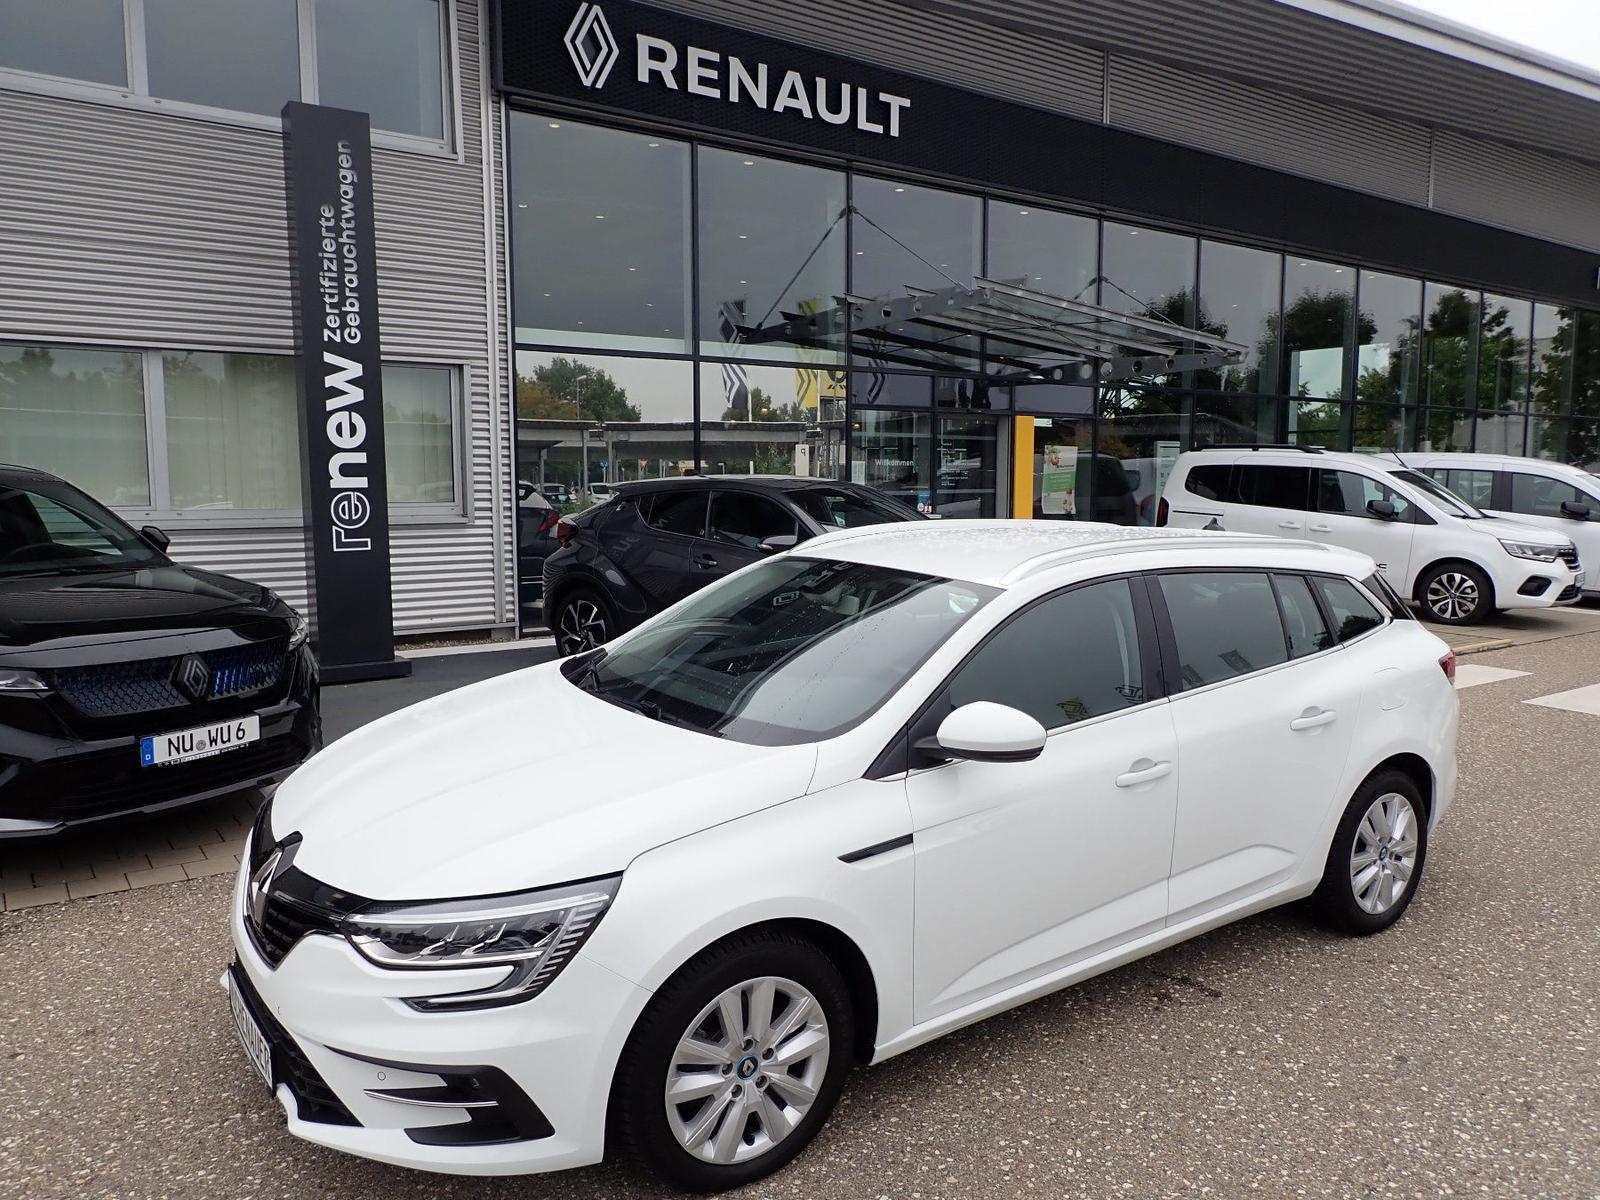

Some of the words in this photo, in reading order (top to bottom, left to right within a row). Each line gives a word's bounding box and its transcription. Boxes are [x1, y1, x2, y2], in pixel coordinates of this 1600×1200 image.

[636, 33, 911, 137] RENAULT
[319, 204, 341, 343] Zertifizierte
[338, 139, 362, 344] Gebrauchtwagen
[323, 351, 371, 552] renew
[874, 458, 915, 467] Willkommen
[168, 733, 194, 756] NU
[208, 725, 231, 747] WU
[236, 722, 246, 740] 6
